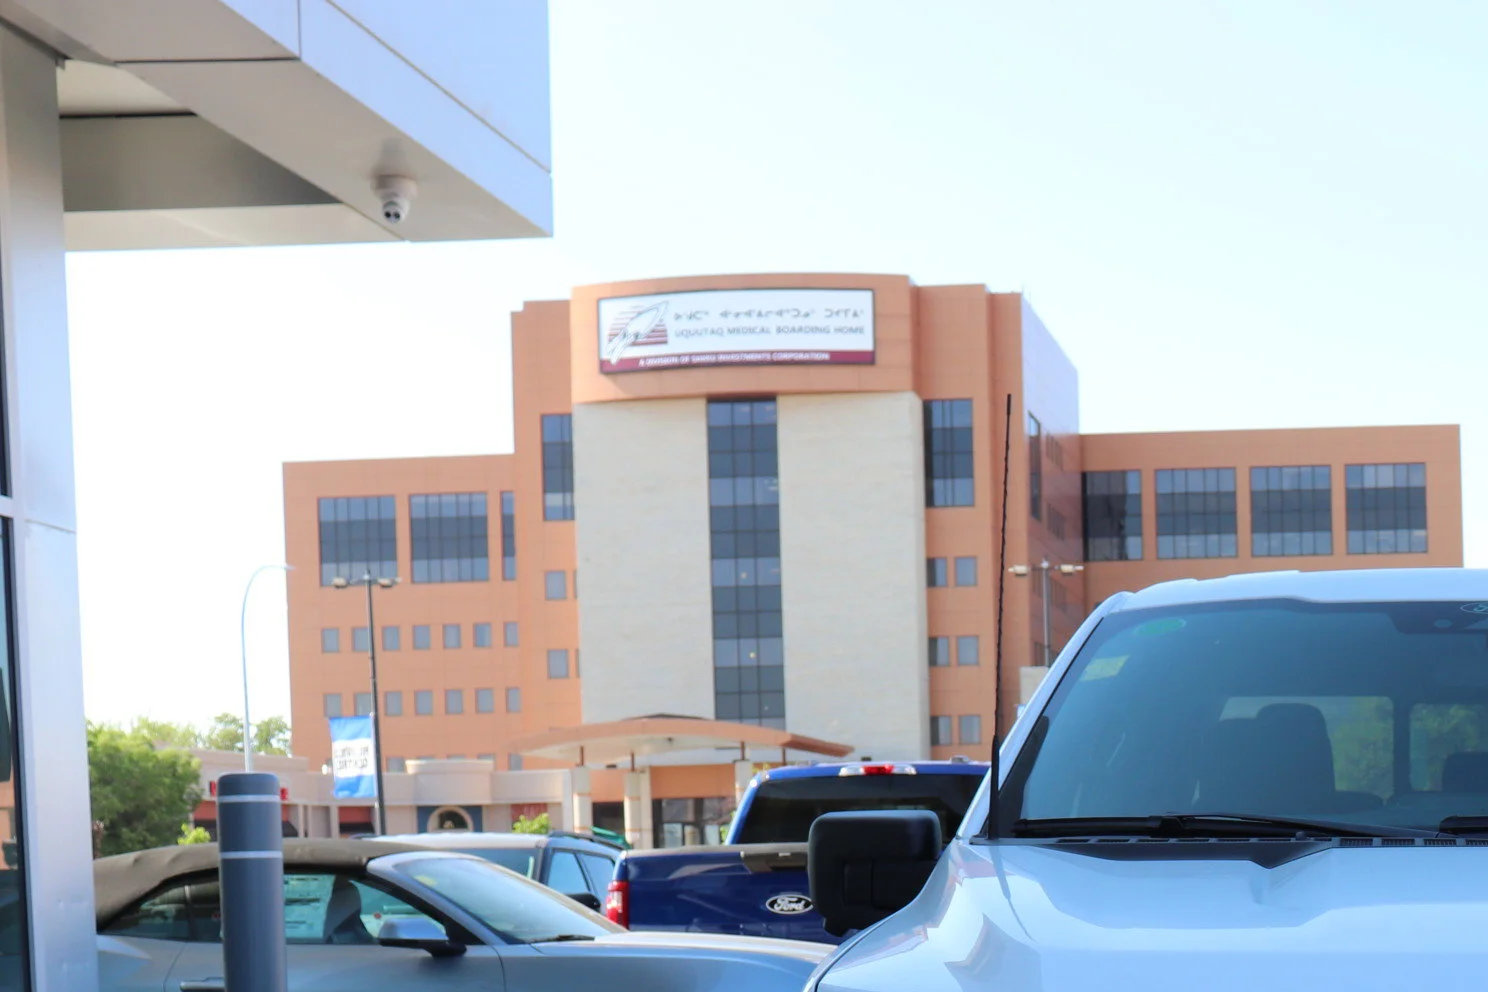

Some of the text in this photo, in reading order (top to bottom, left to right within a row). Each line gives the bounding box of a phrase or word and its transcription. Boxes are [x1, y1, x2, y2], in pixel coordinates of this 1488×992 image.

[726, 325, 771, 336] MEDICAL
[775, 324, 831, 335] BOARDING
[833, 324, 865, 335] HOME
[774, 896, 806, 911] Ford
